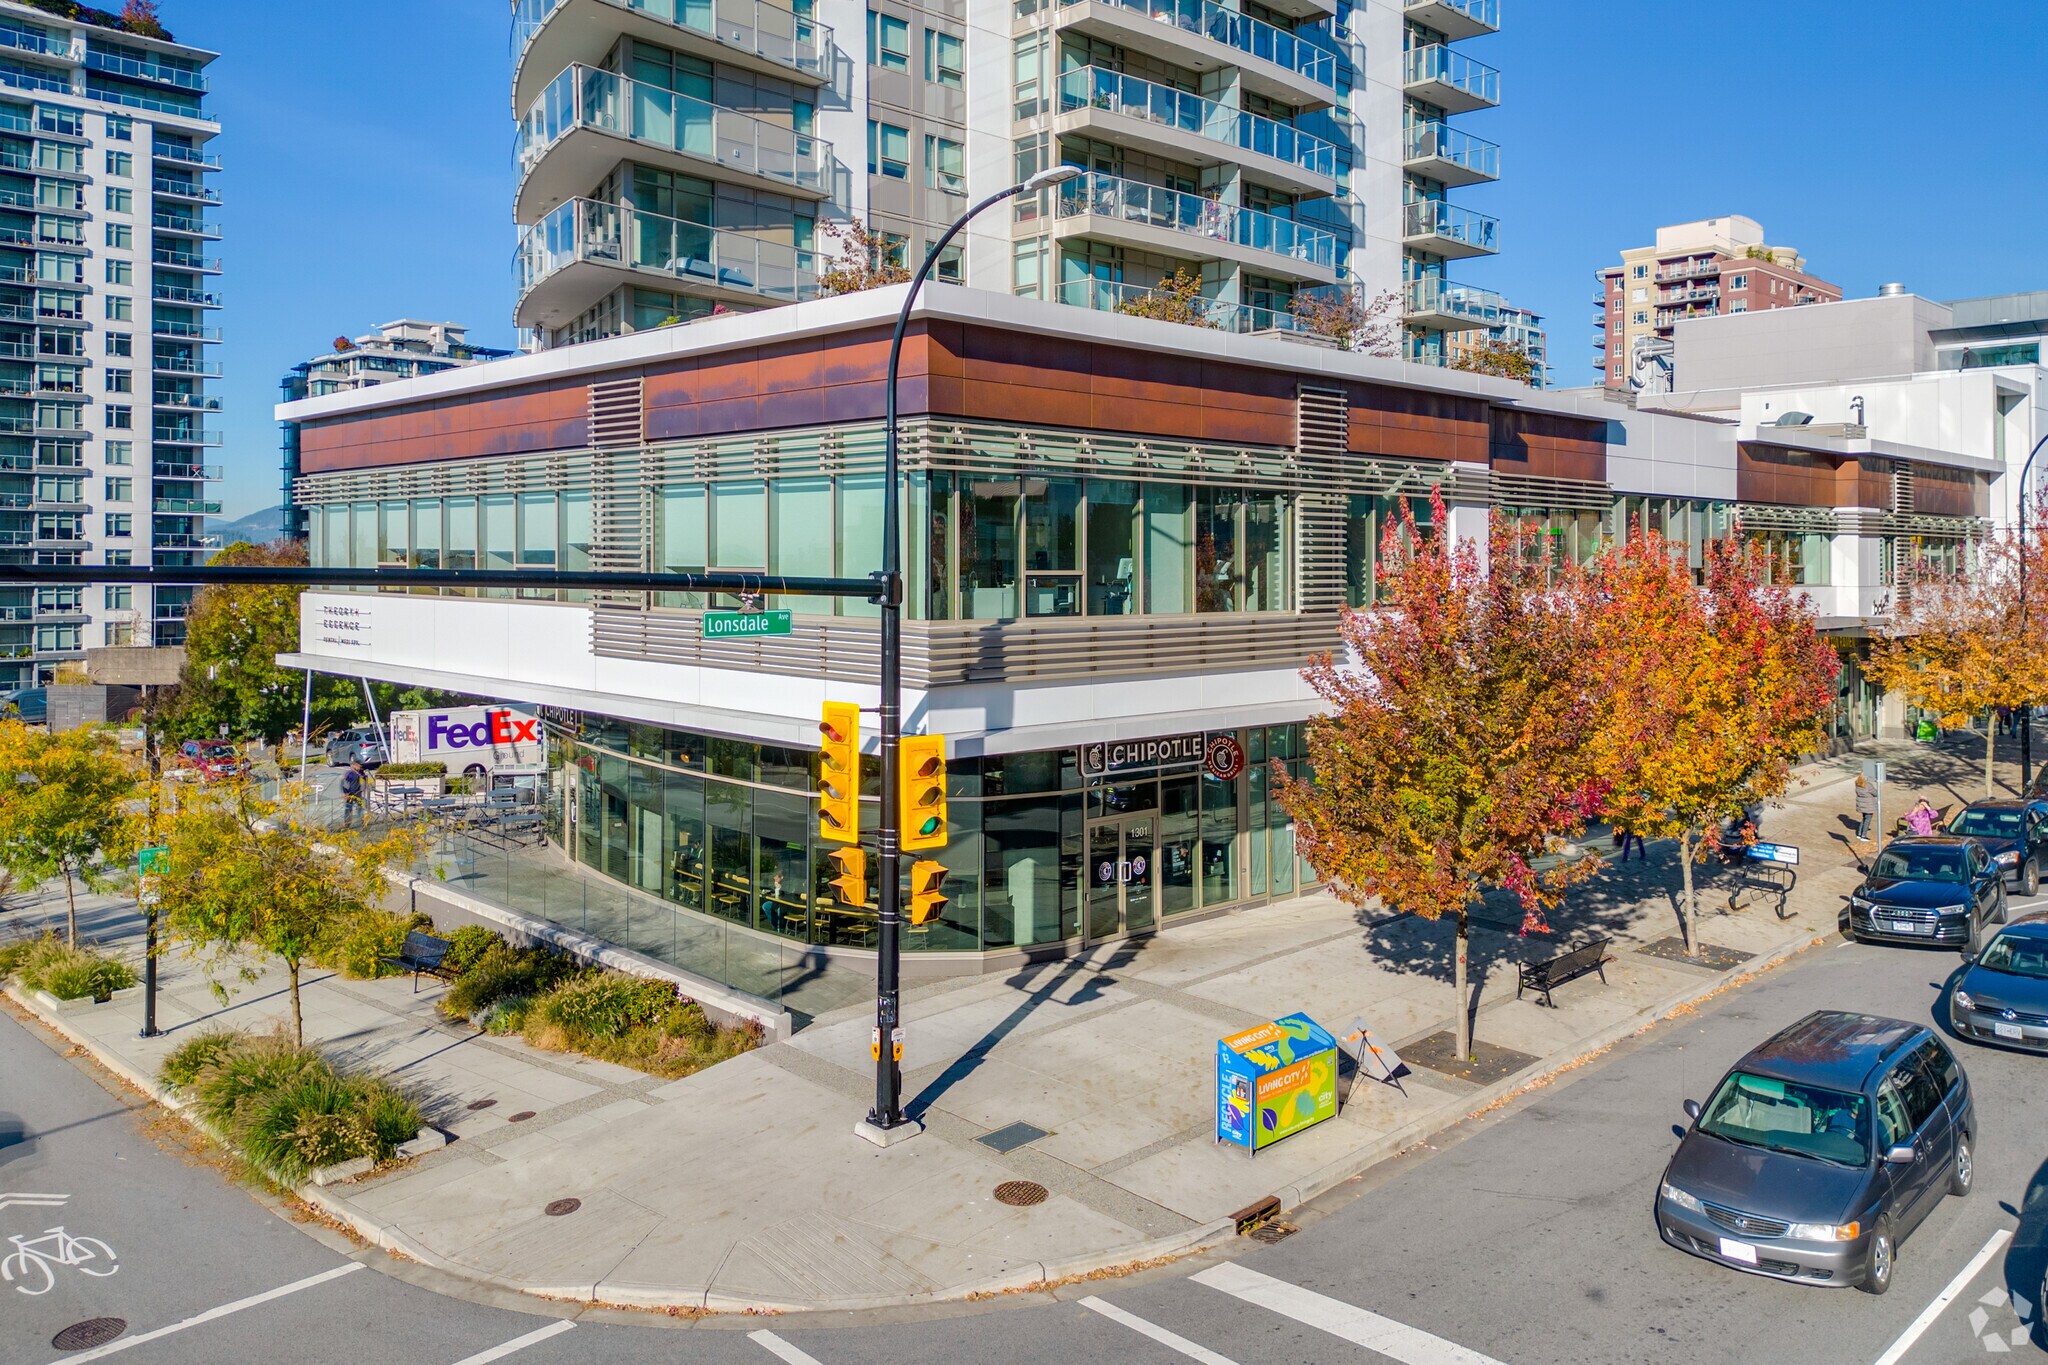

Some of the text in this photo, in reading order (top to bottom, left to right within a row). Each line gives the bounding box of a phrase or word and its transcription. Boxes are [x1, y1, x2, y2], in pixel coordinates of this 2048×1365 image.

[708, 613, 789, 633] Lonsdale Ave
[546, 705, 574, 726] CHIPOTLE
[393, 725, 416, 743] FedEx
[428, 710, 538, 750] FedEx
[493, 749, 525, 760] Ground
[1112, 737, 1202, 765] CHIPOTLE
[1207, 737, 1239, 757] CHIPOTLE
[1131, 826, 1148, 838] 1301
[1253, 1028, 1272, 1040] CITY
[1258, 1076, 1284, 1095] LIVING
[1283, 1070, 1301, 1085] CITY
[1221, 1073, 1233, 1133] RECYCLE
[1318, 1090, 1333, 1102] city
